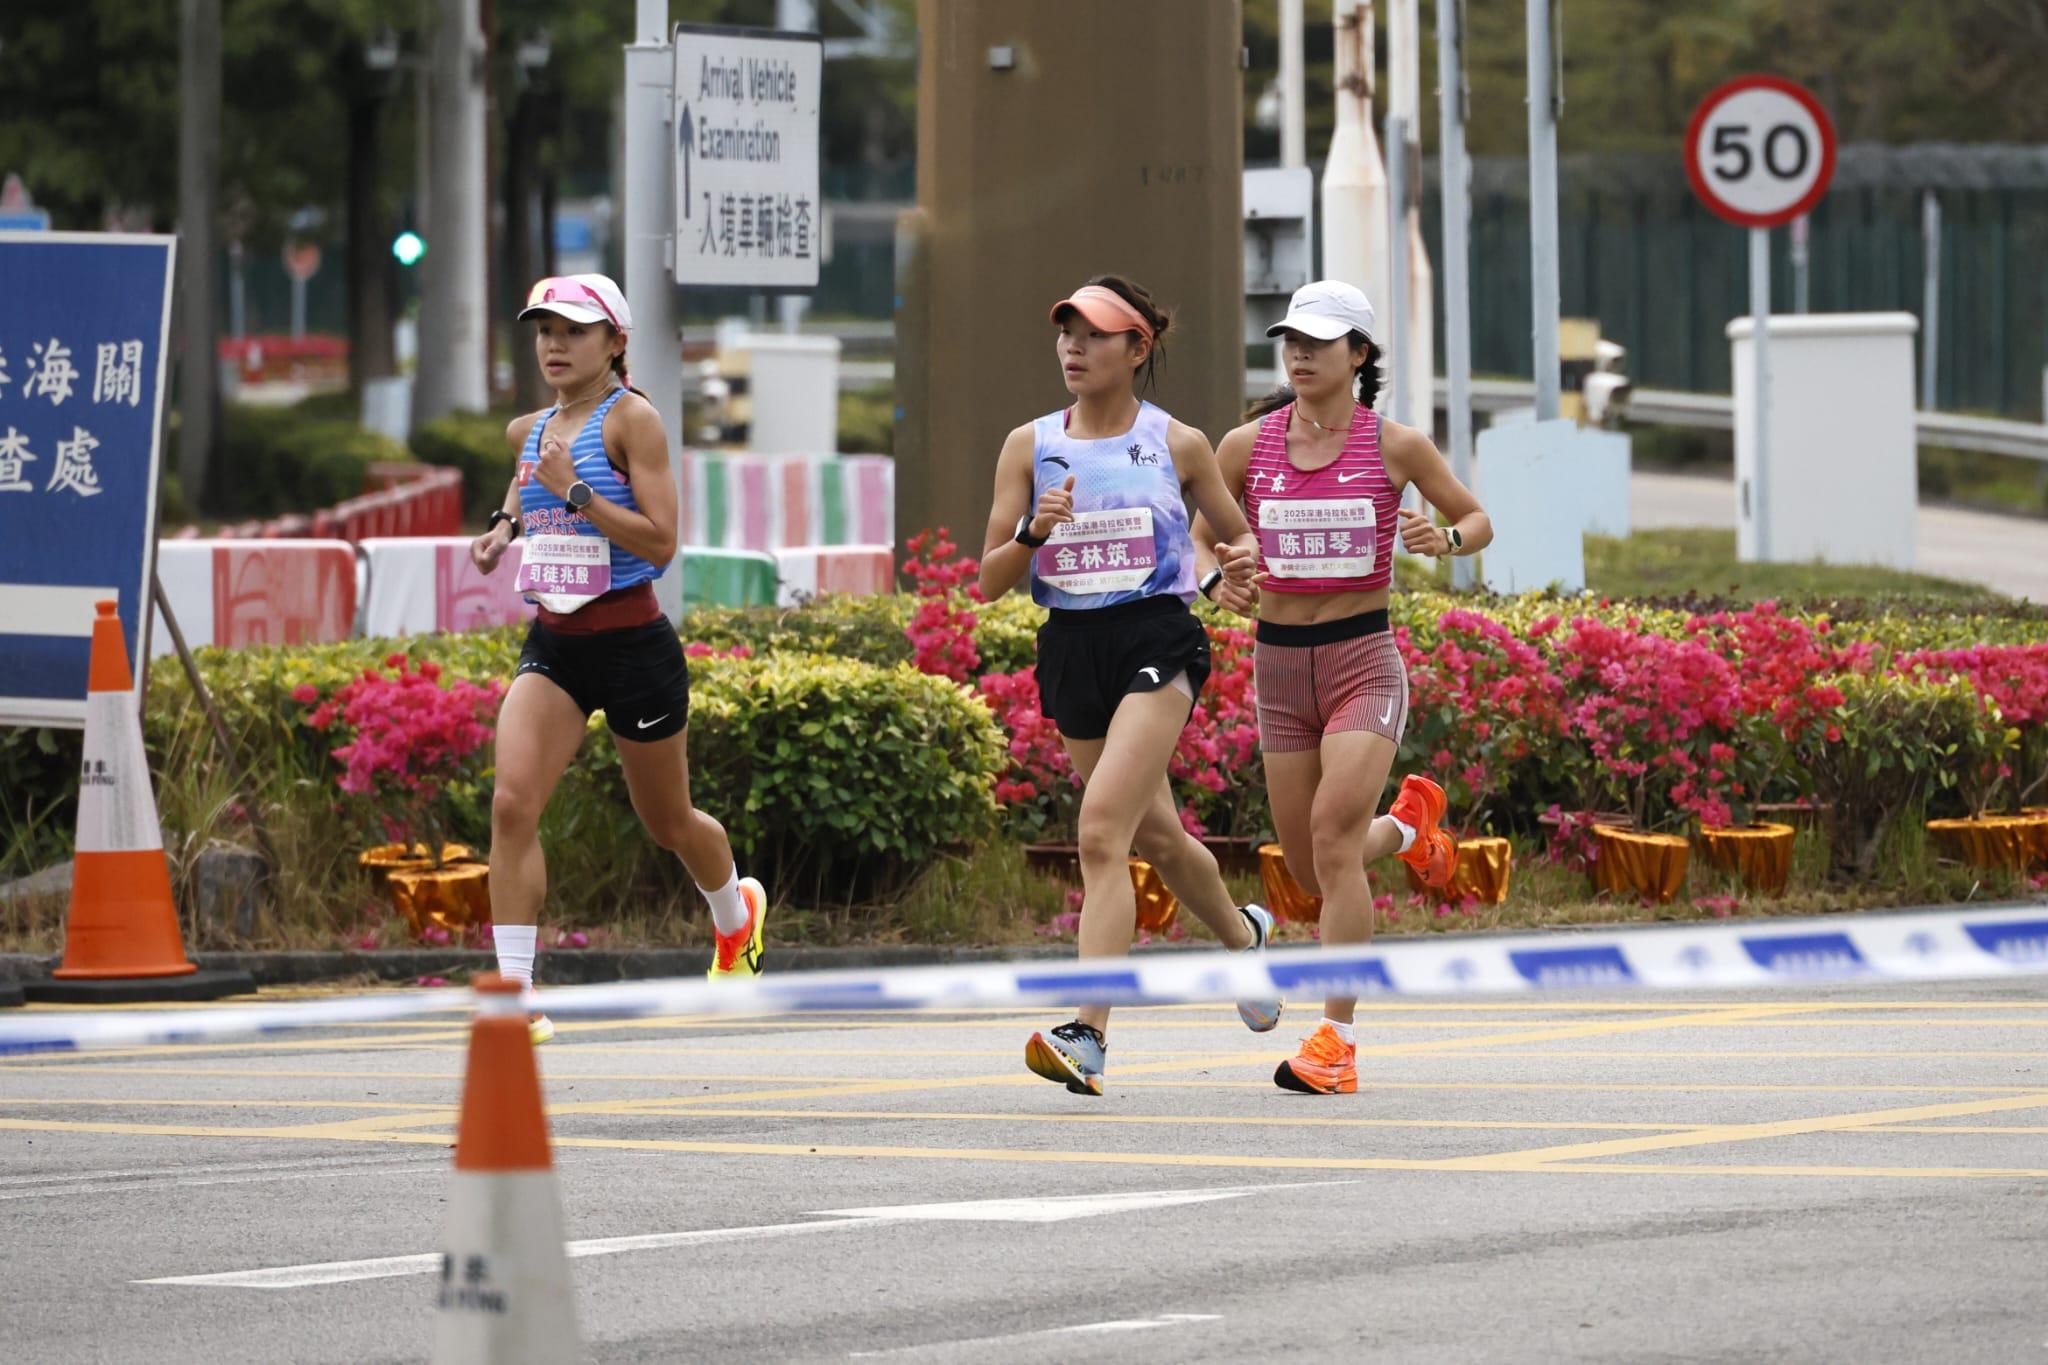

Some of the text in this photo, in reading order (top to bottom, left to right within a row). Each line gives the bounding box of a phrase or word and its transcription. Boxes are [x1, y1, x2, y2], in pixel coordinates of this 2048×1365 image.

[700, 54, 797, 103] Arrival Vehicle
[699, 115, 781, 162] Examination
[1713, 124, 1809, 181] 50
[700, 191, 812, 258] 入境車輛檢查
[522, 506, 591, 531] ONG KON
[1055, 542, 1152, 572] 金林筑 203
[1278, 531, 1371, 557] 陈丽琴 20
